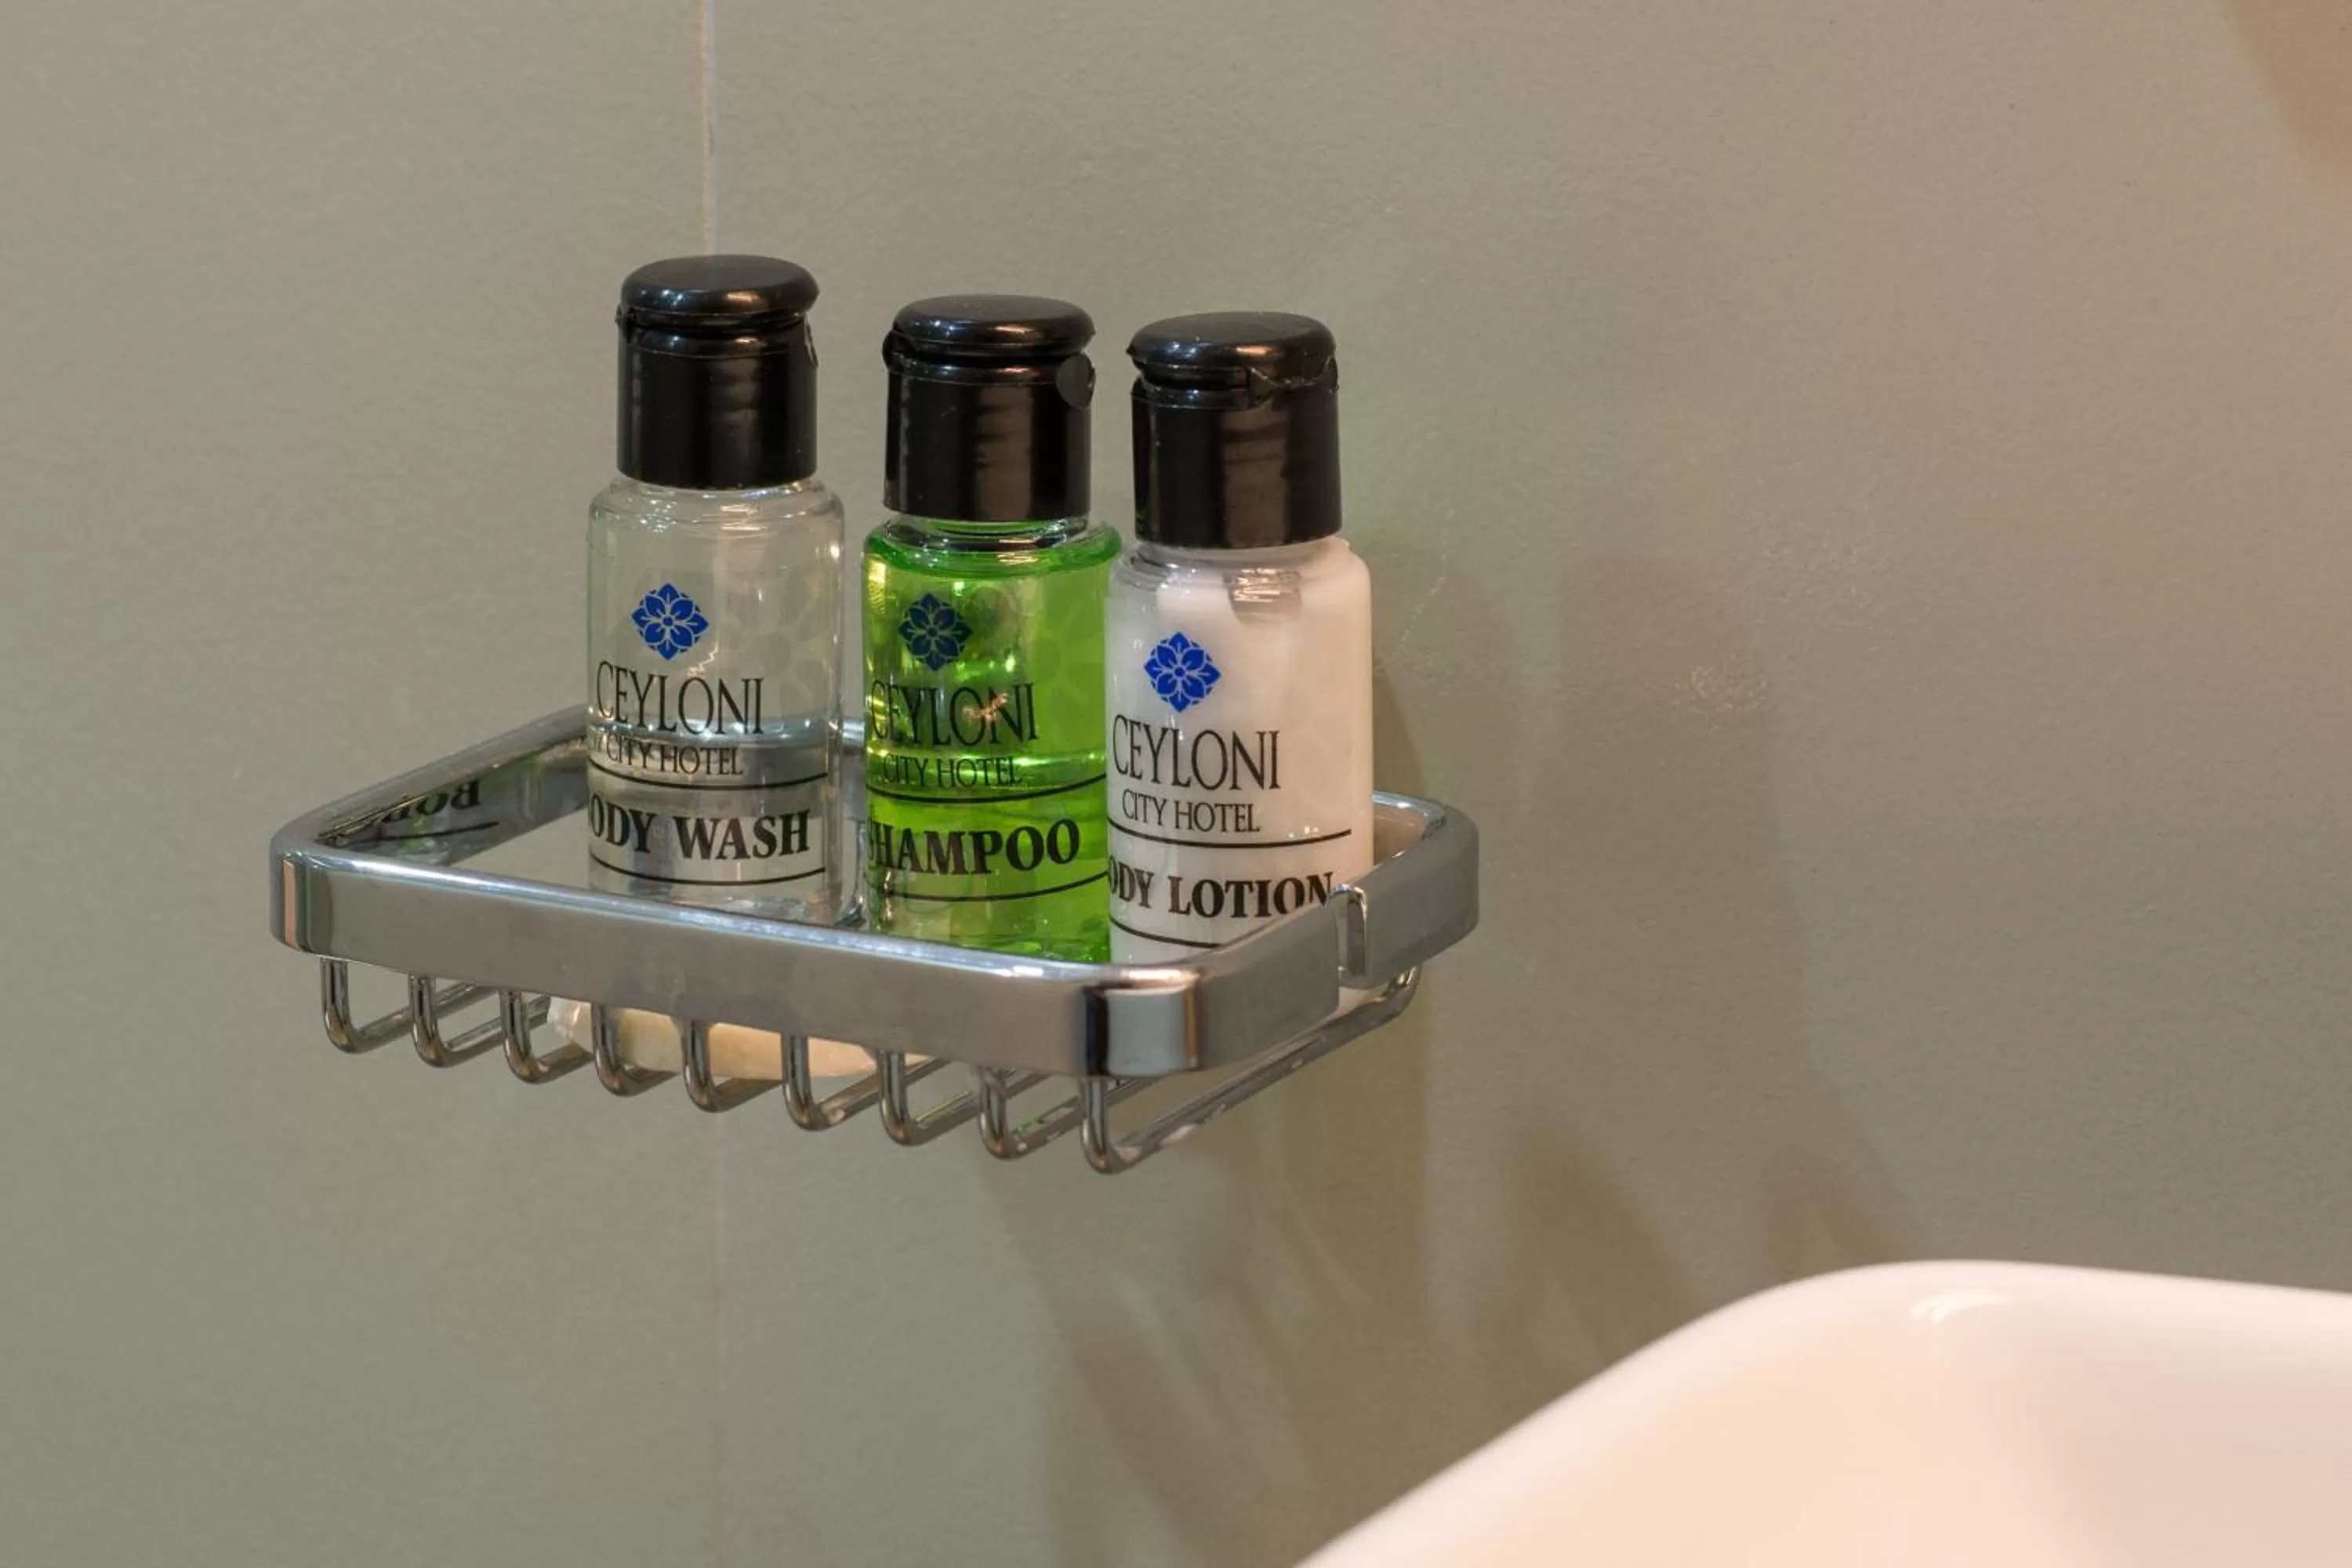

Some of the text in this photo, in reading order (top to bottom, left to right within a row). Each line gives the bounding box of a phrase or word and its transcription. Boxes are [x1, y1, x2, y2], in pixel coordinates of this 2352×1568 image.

[596, 660, 764, 735] CEYLONI
[870, 680, 1040, 747] CEYLONI
[607, 734, 743, 775] CITY HOTEL
[884, 753, 1023, 788] CITY HOTEL
[1112, 713, 1281, 791] CEYLONI
[590, 793, 811, 860] ODY WASH
[1123, 789, 1261, 833] CITY HOTEL
[1109, 855, 1334, 917] ODY LOTION
